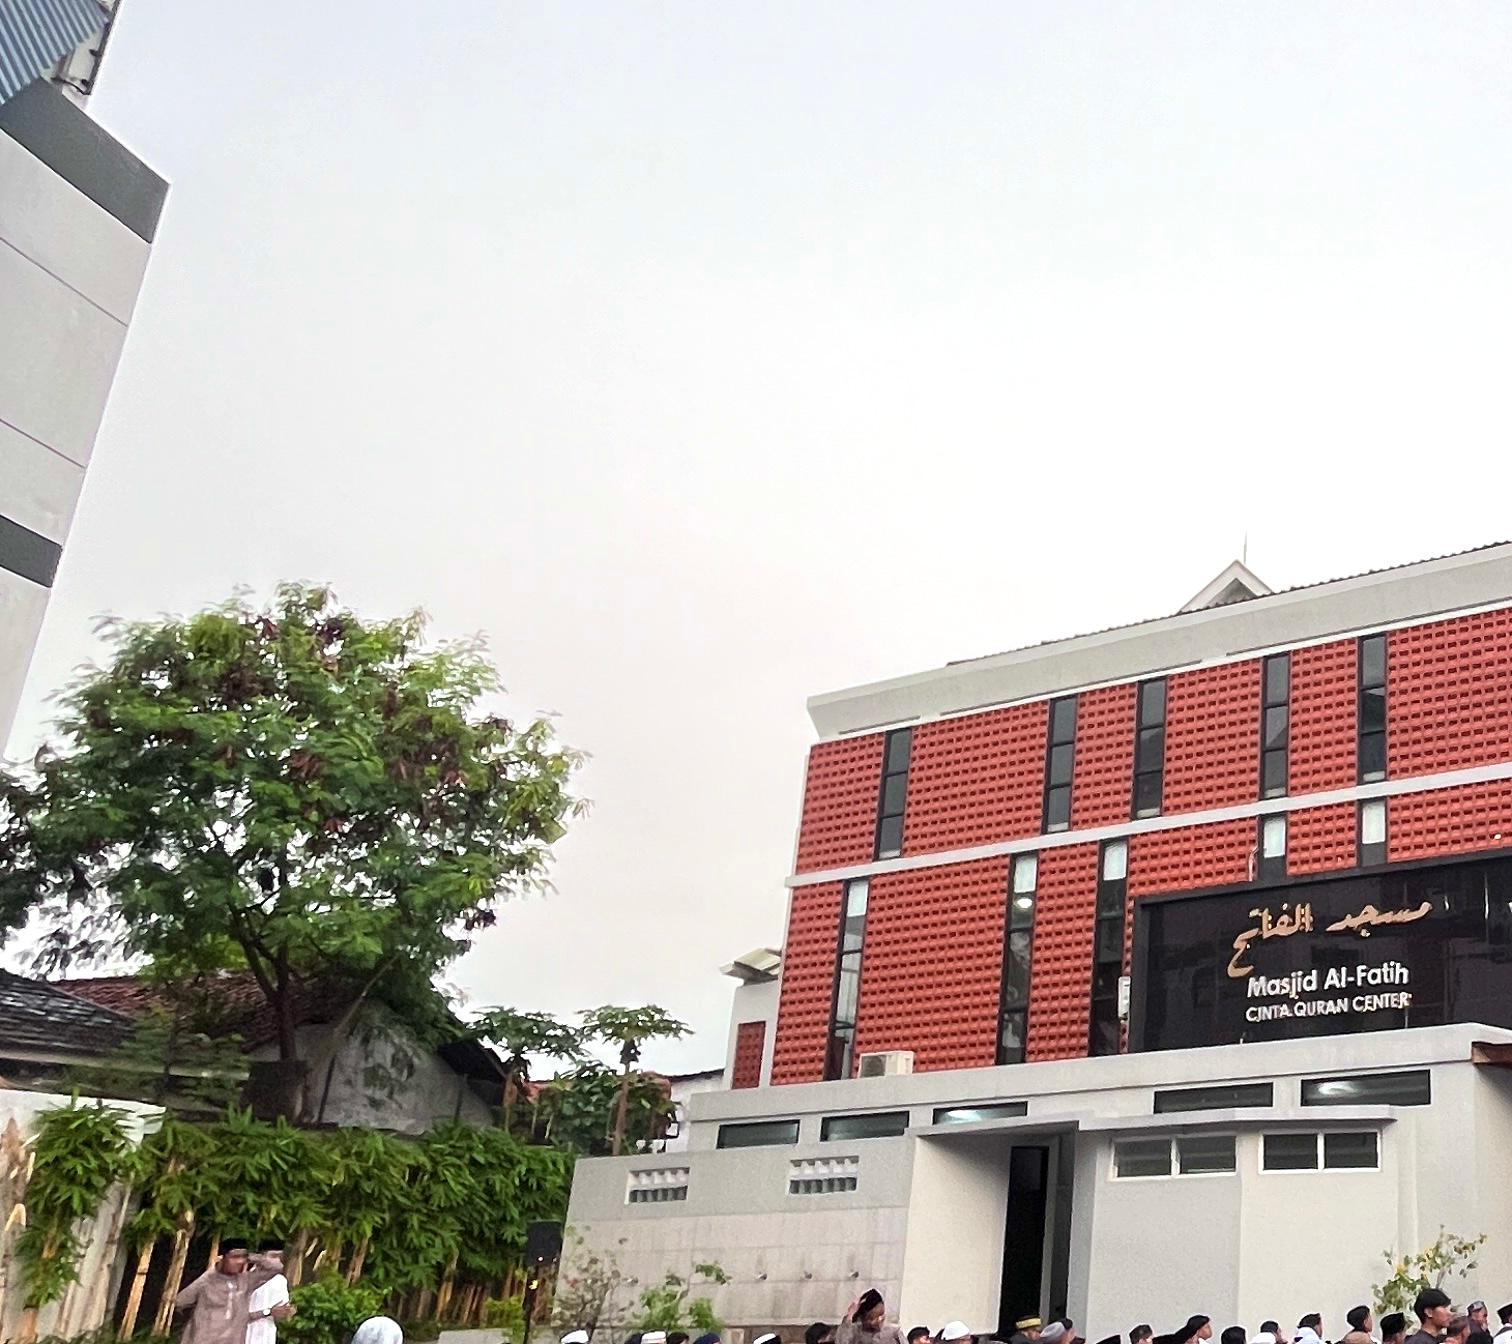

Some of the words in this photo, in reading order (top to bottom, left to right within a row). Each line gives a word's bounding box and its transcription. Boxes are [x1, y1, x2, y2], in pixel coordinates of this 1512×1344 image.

[1325, 902, 1433, 938] مسجد
[1227, 903, 1314, 978] الفاتح
[1247, 969, 1318, 999] Masjid
[1324, 960, 1409, 990] Al-Fatih
[1245, 1003, 1292, 1022] CINTA
[1293, 997, 1349, 1017] QURAN
[1352, 991, 1411, 1012] CENTER
